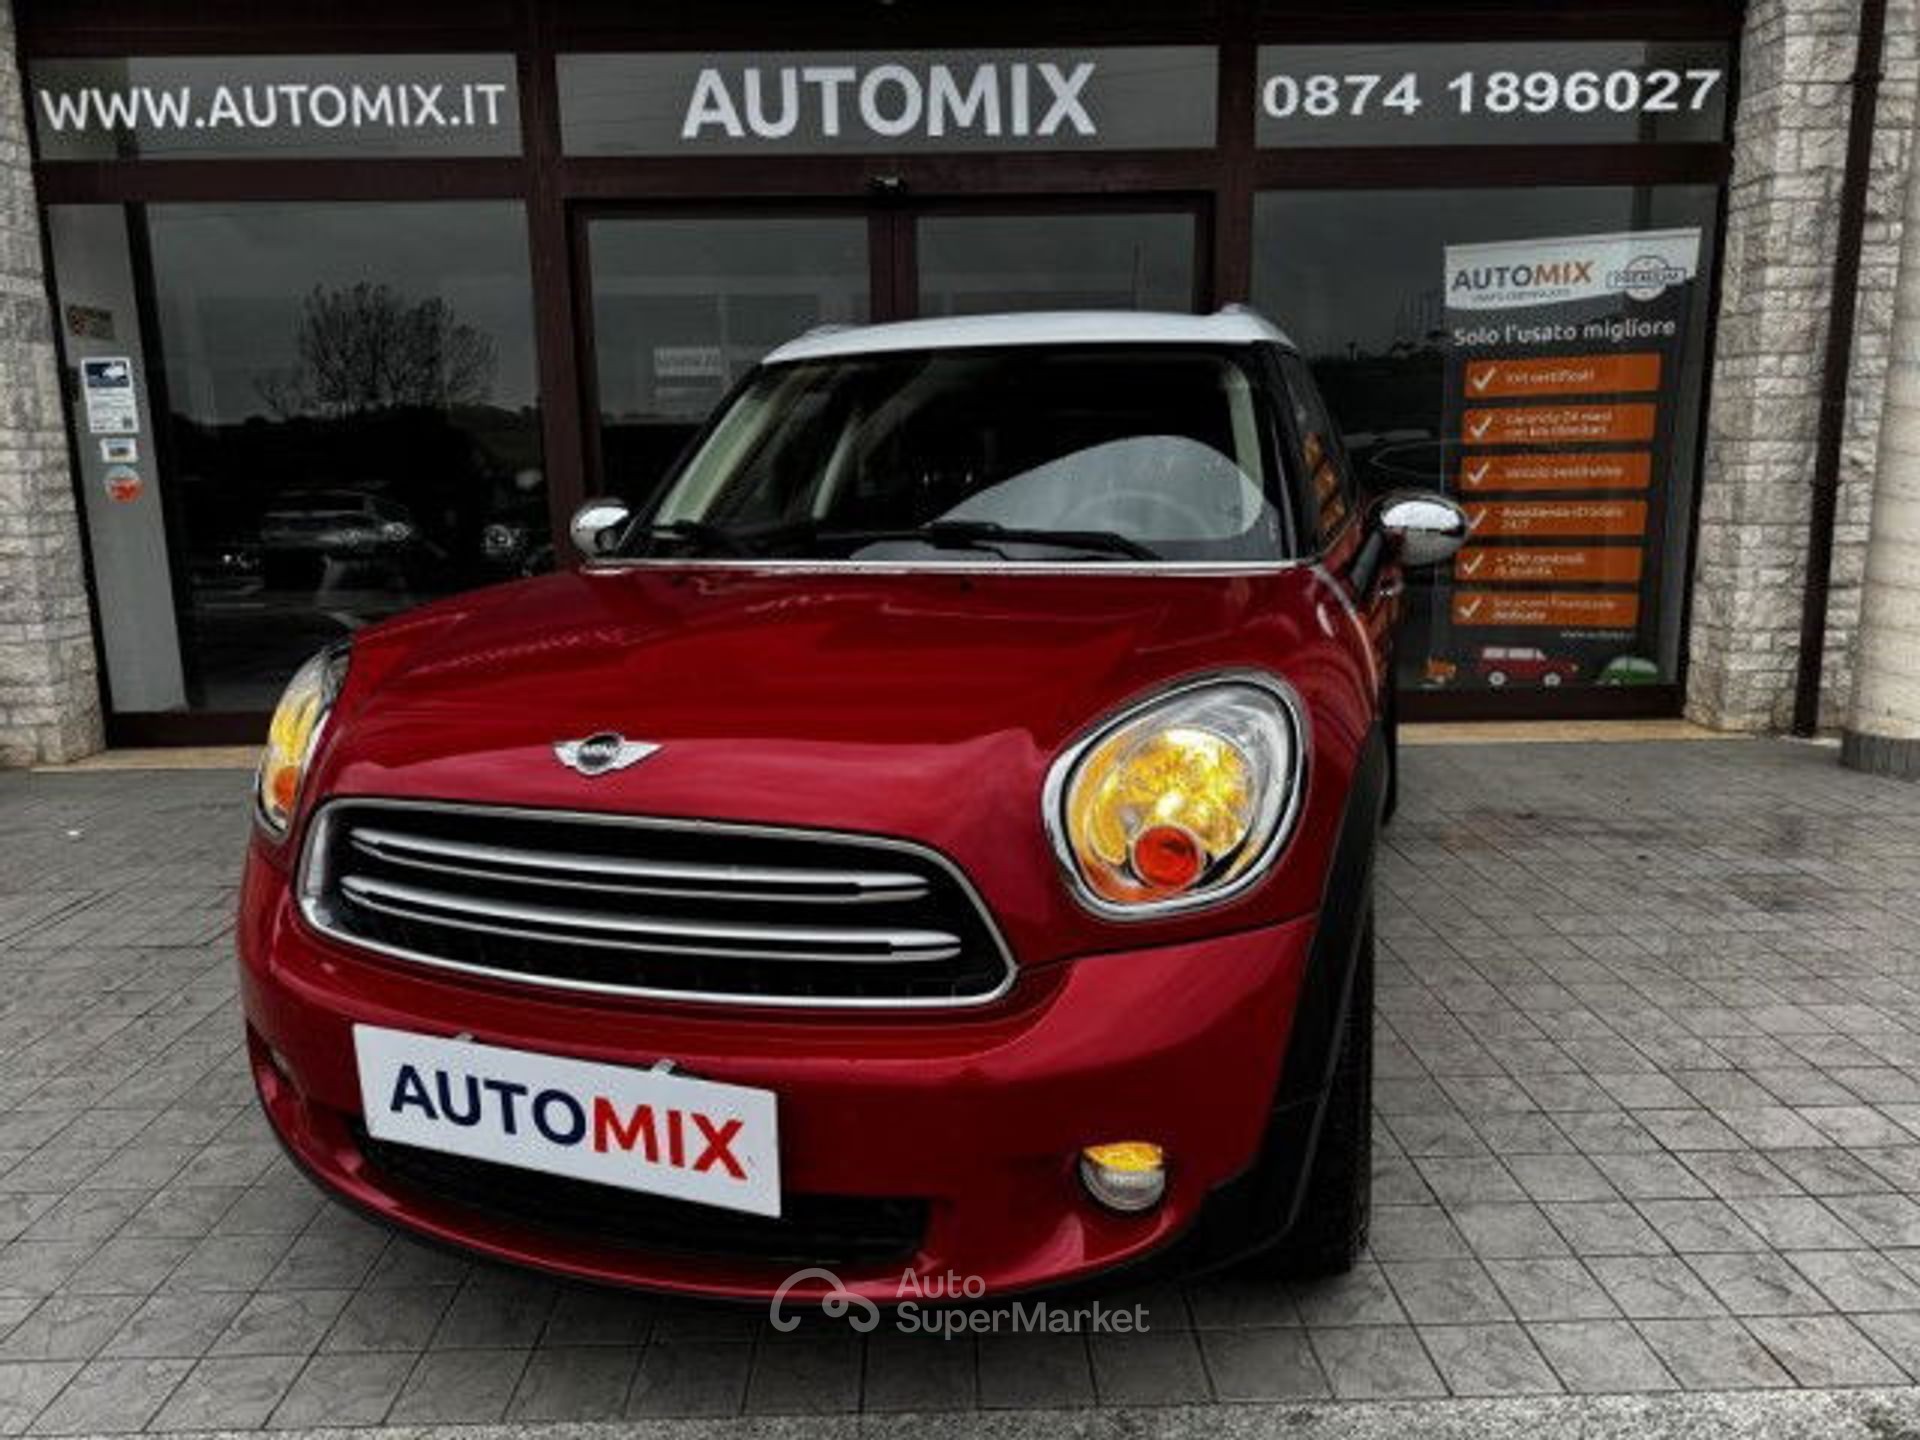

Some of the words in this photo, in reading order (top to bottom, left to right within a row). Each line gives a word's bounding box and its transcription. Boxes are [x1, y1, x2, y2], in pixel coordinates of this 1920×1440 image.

[40, 83, 506, 131] WWW.AUTOMIX.IT
[681, 62, 1098, 139] AUTOMIX
[1262, 72, 1422, 117] 0874
[1447, 69, 1722, 114] 1896027
[1452, 261, 1594, 291] AUTOMIX
[1453, 326, 1499, 347] Solo
[1505, 322, 1578, 342] l'usato
[1584, 318, 1676, 342] migliore
[389, 1064, 748, 1180] AUTOMIX
